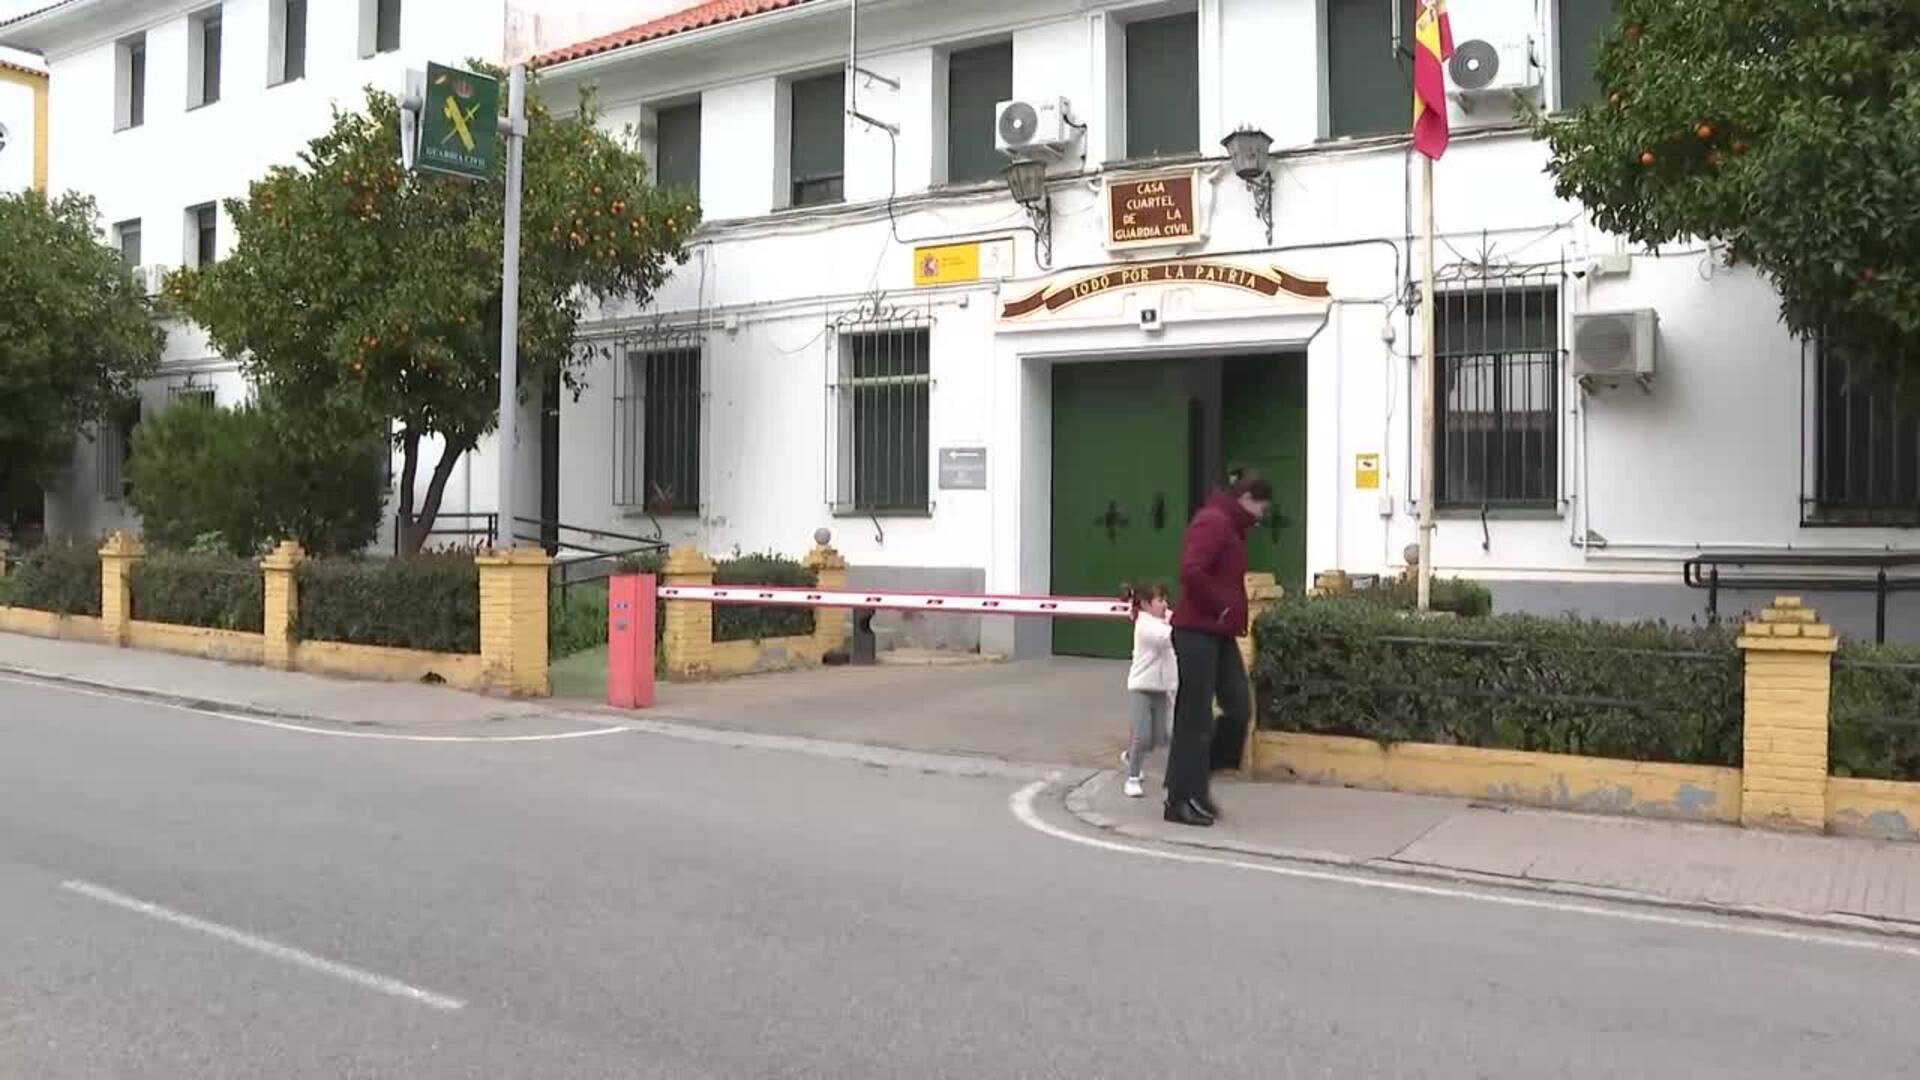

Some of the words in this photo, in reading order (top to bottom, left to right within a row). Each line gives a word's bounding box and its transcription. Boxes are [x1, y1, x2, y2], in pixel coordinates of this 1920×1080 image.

[1136, 182, 1165, 194] CASA
[1126, 195, 1175, 210] CUARTEL
[1122, 212, 1137, 225] DE
[1166, 208, 1182, 220] LA
[1115, 225, 1161, 240] GUARDIA
[1164, 223, 1190, 235] CIVIL
[1070, 276, 1110, 299] TODO
[1121, 269, 1150, 284] POR
[1164, 265, 1184, 279] LA
[1195, 266, 1257, 289] PATRIA
